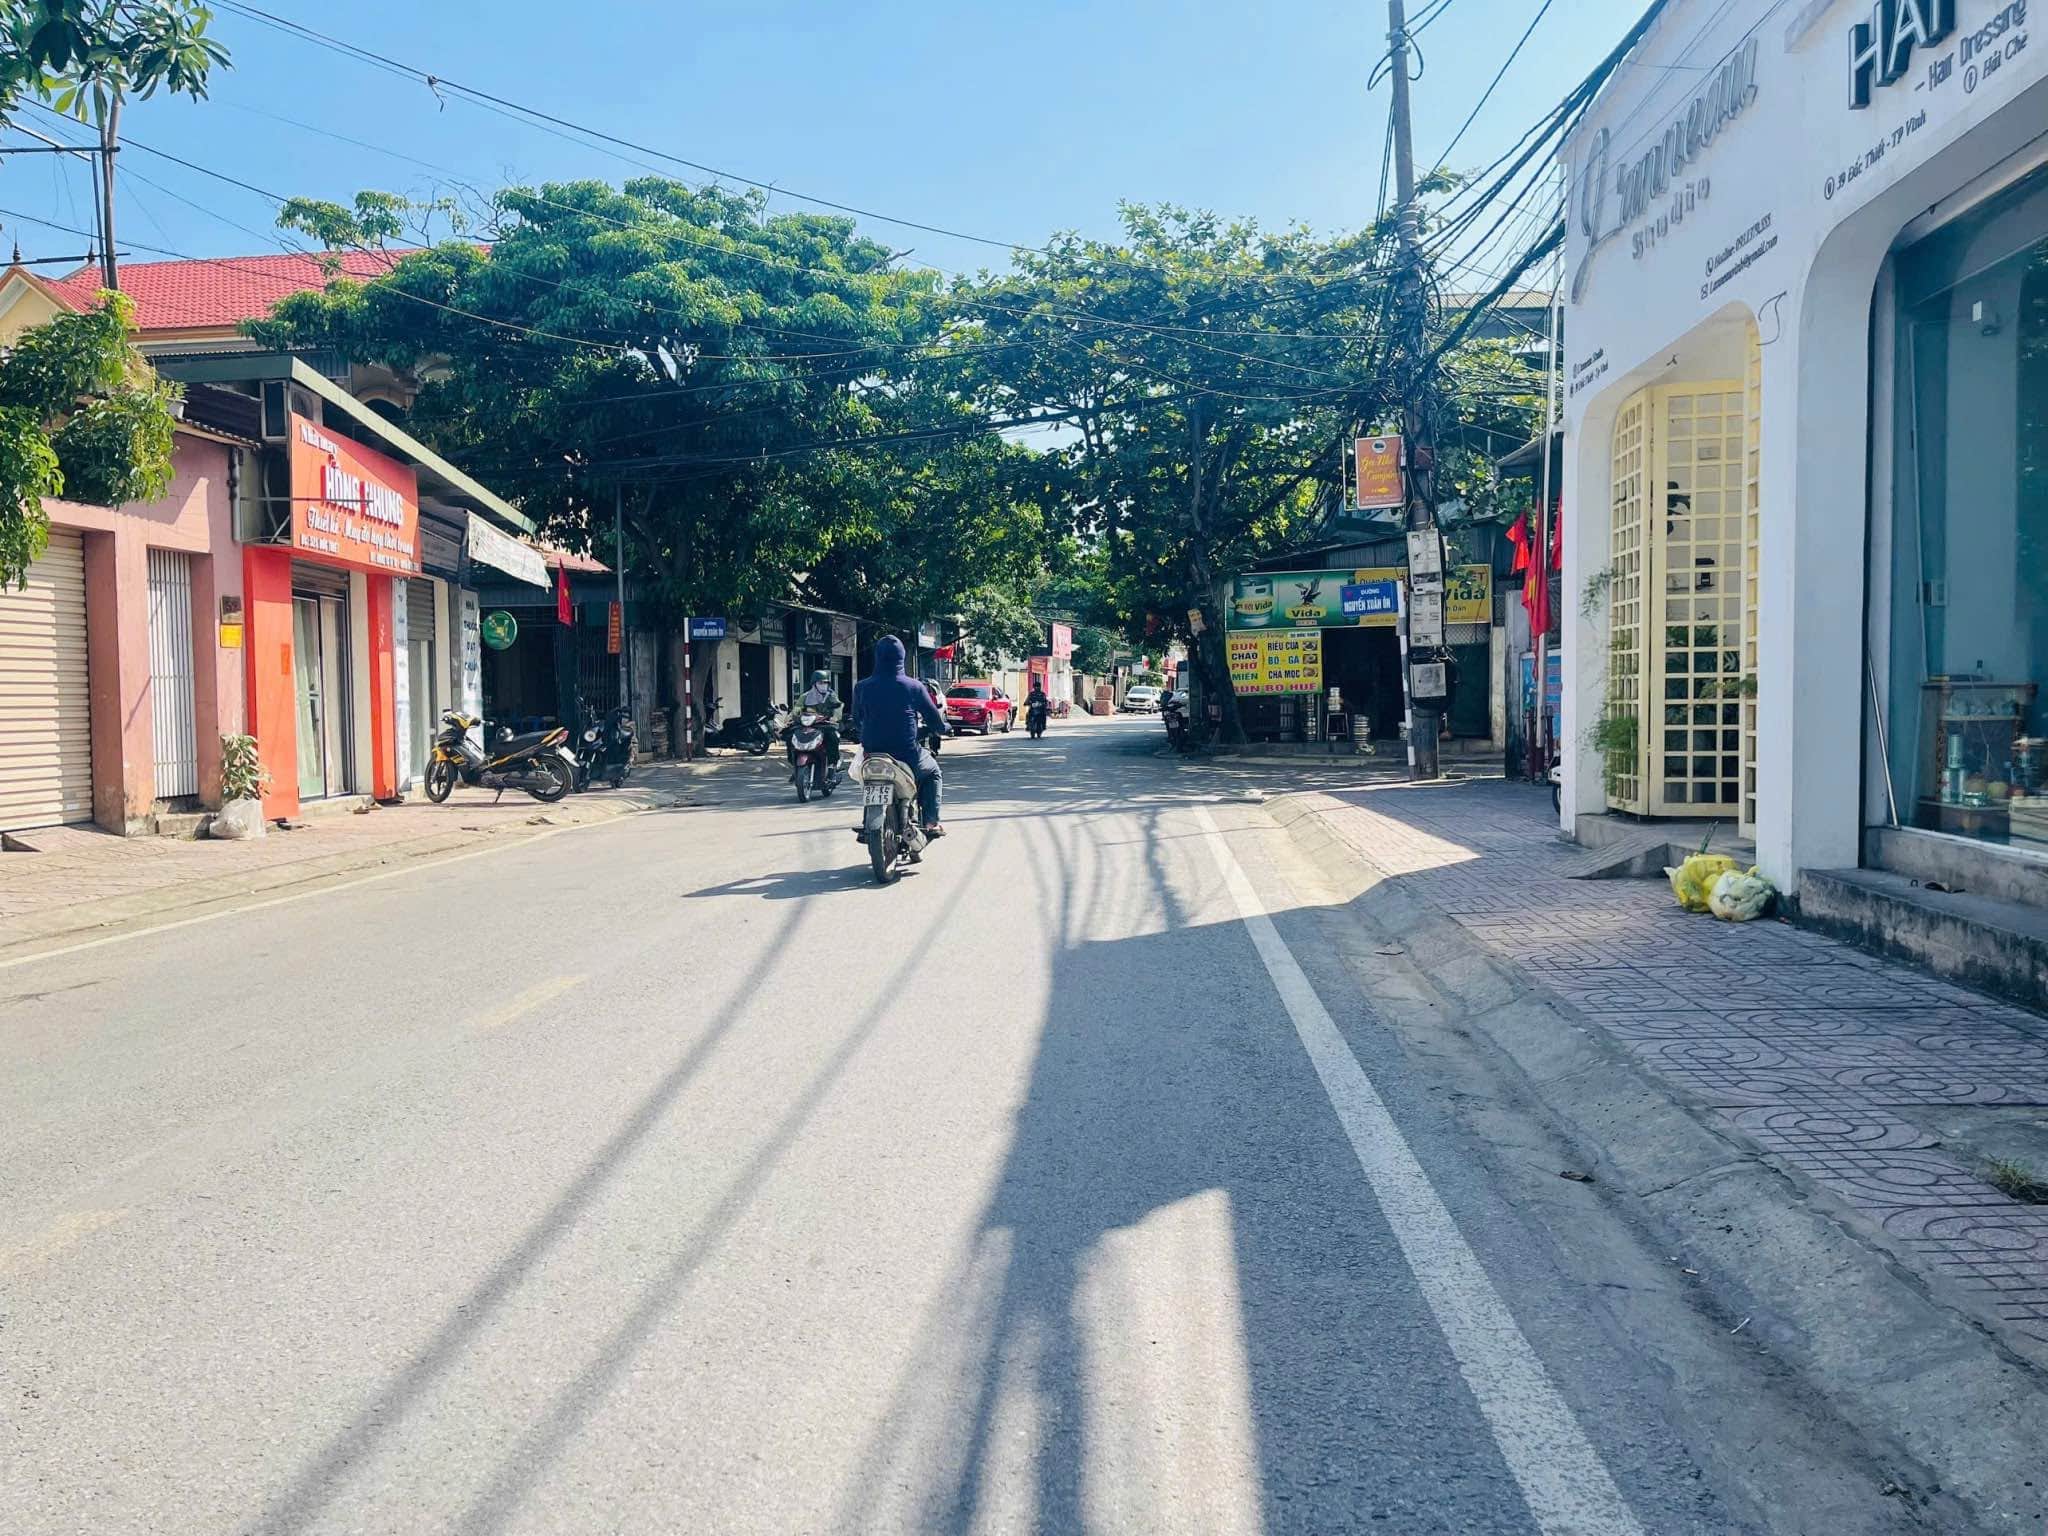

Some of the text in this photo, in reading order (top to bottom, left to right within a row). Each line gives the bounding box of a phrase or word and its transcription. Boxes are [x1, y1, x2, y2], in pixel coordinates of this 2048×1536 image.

[1928, 52, 1954, 92] Hair
[1344, 597, 1366, 612] NGUYỄN
[1366, 596, 1382, 610] XUÂN
[1291, 609, 1321, 619] Vida
